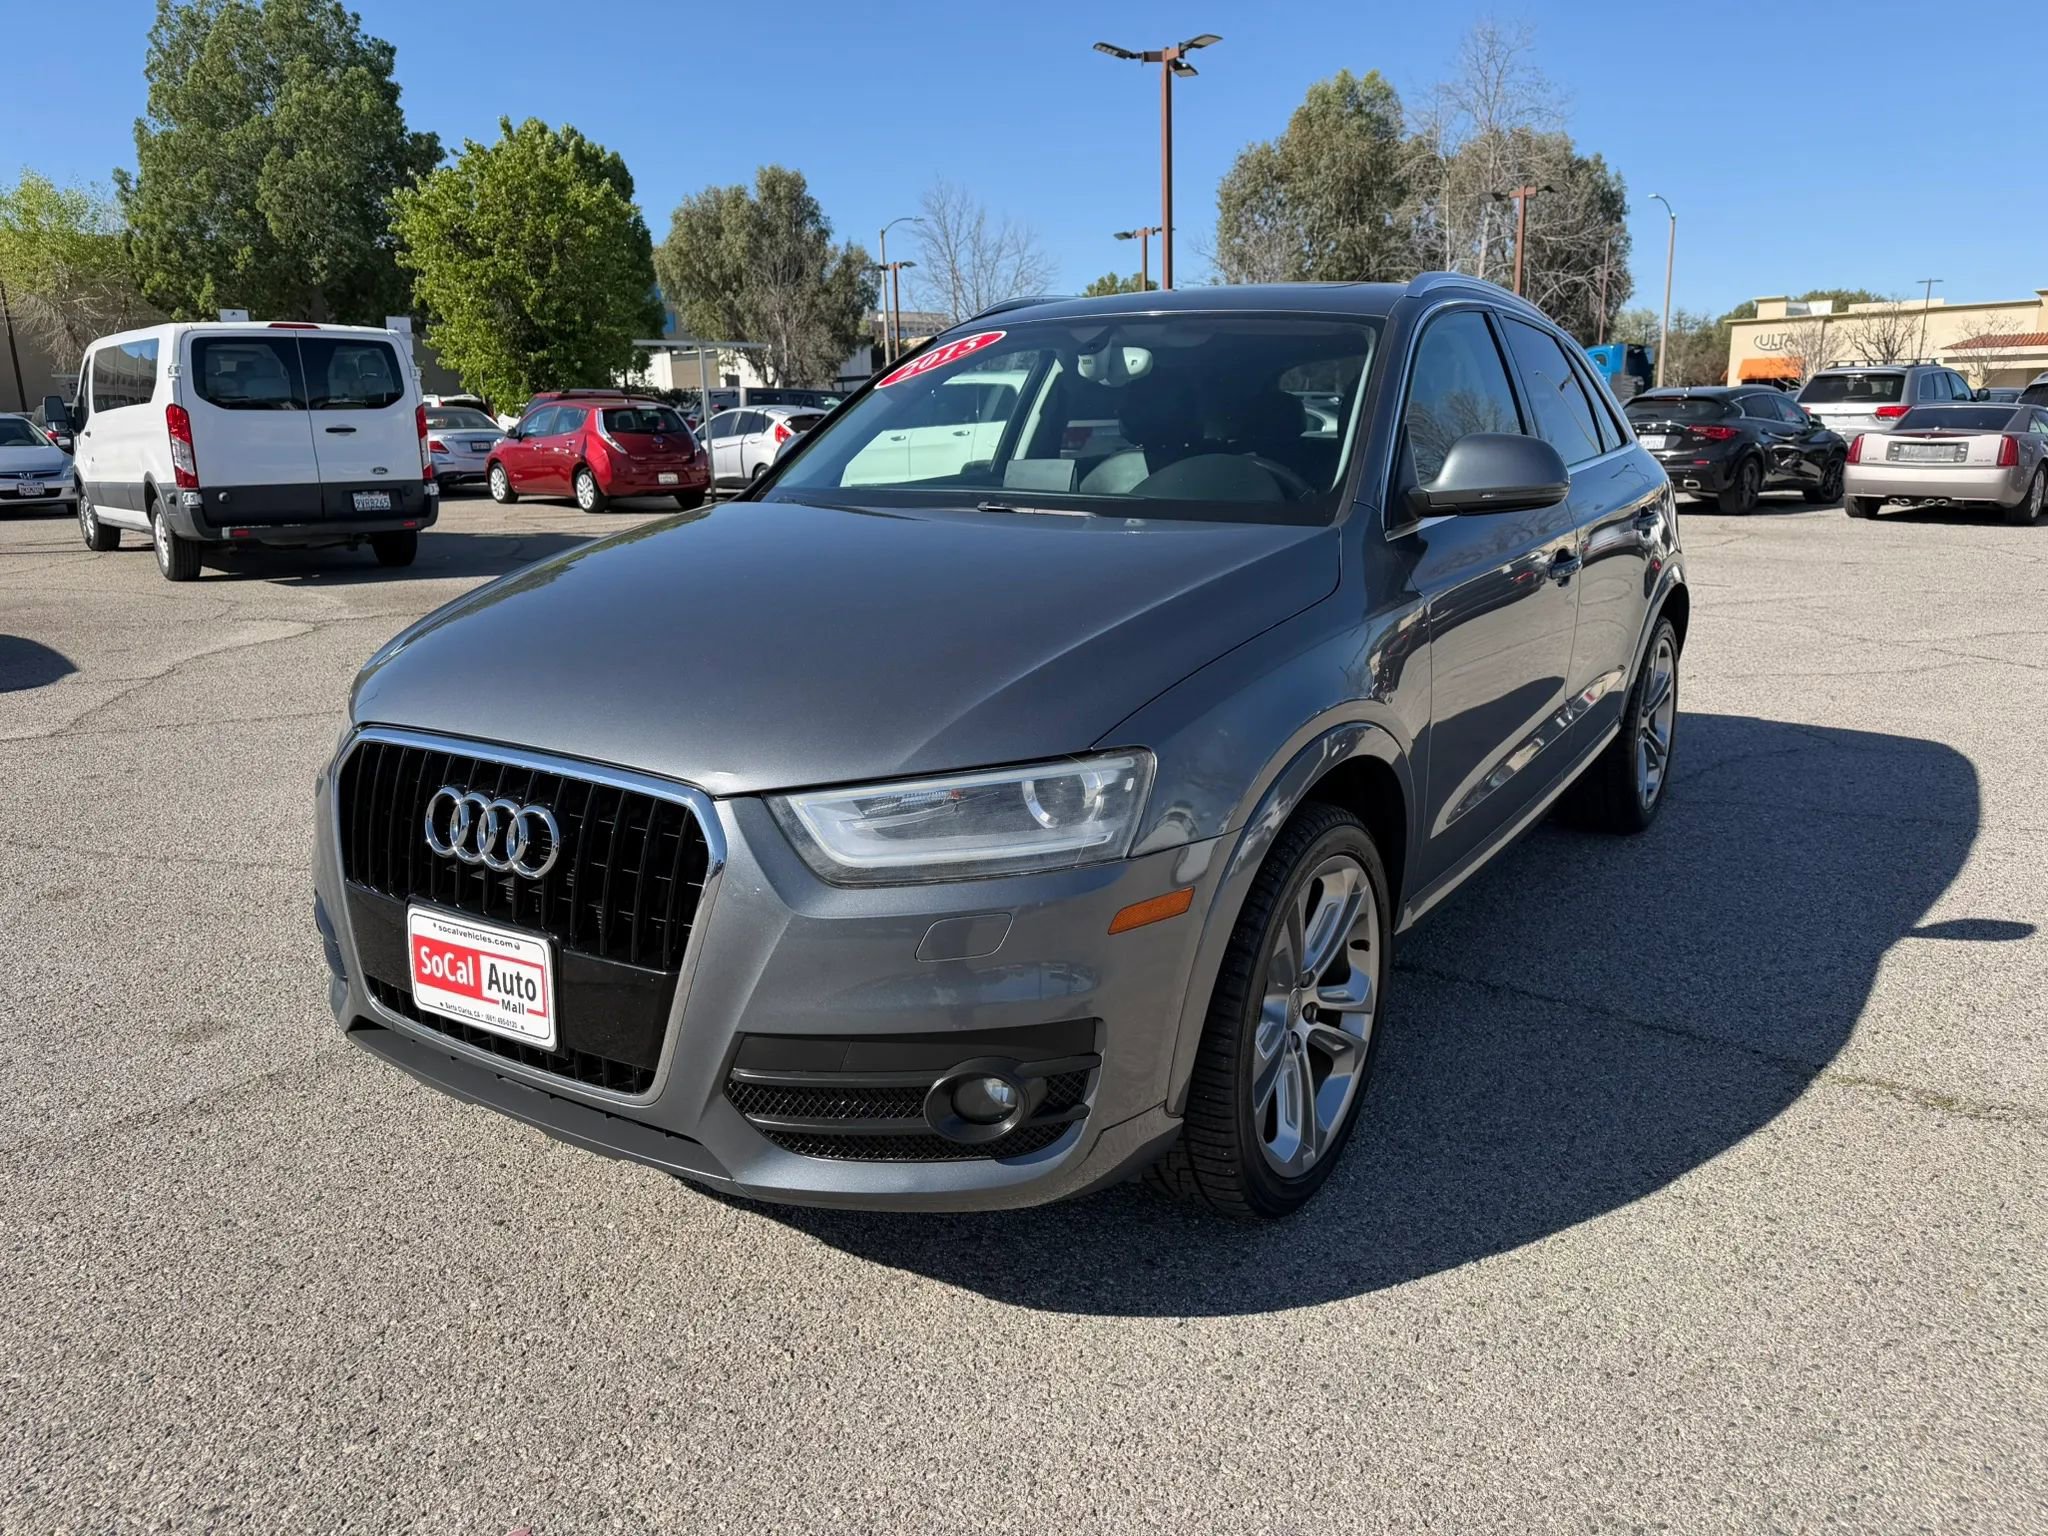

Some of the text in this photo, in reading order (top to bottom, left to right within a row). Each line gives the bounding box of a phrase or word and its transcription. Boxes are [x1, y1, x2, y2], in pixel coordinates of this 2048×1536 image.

[895, 336, 983, 381] 2015
[438, 926, 513, 947] socalvehicles.com
[420, 945, 537, 1001] SoCal Auto
[501, 998, 525, 1016] Mall
